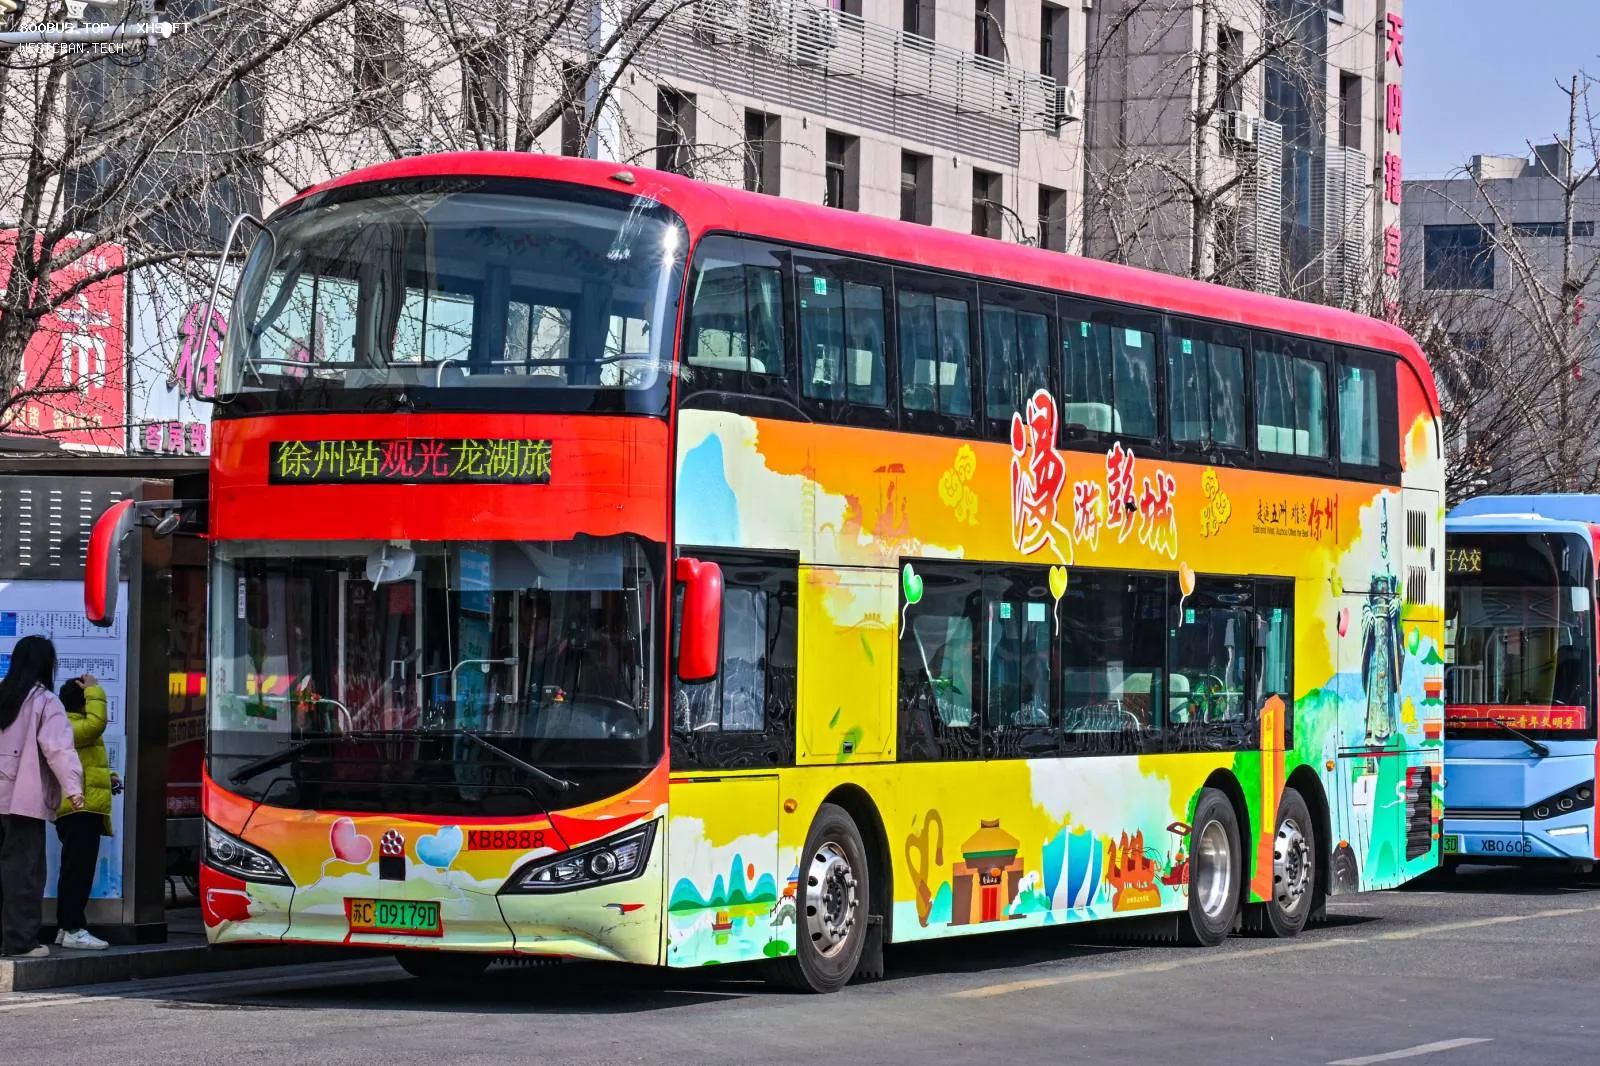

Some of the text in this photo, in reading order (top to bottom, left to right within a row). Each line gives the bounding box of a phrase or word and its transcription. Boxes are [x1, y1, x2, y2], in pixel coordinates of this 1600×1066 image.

[1010, 388, 1178, 567] 漫游彭城
[1481, 839, 1532, 852] XB0605
